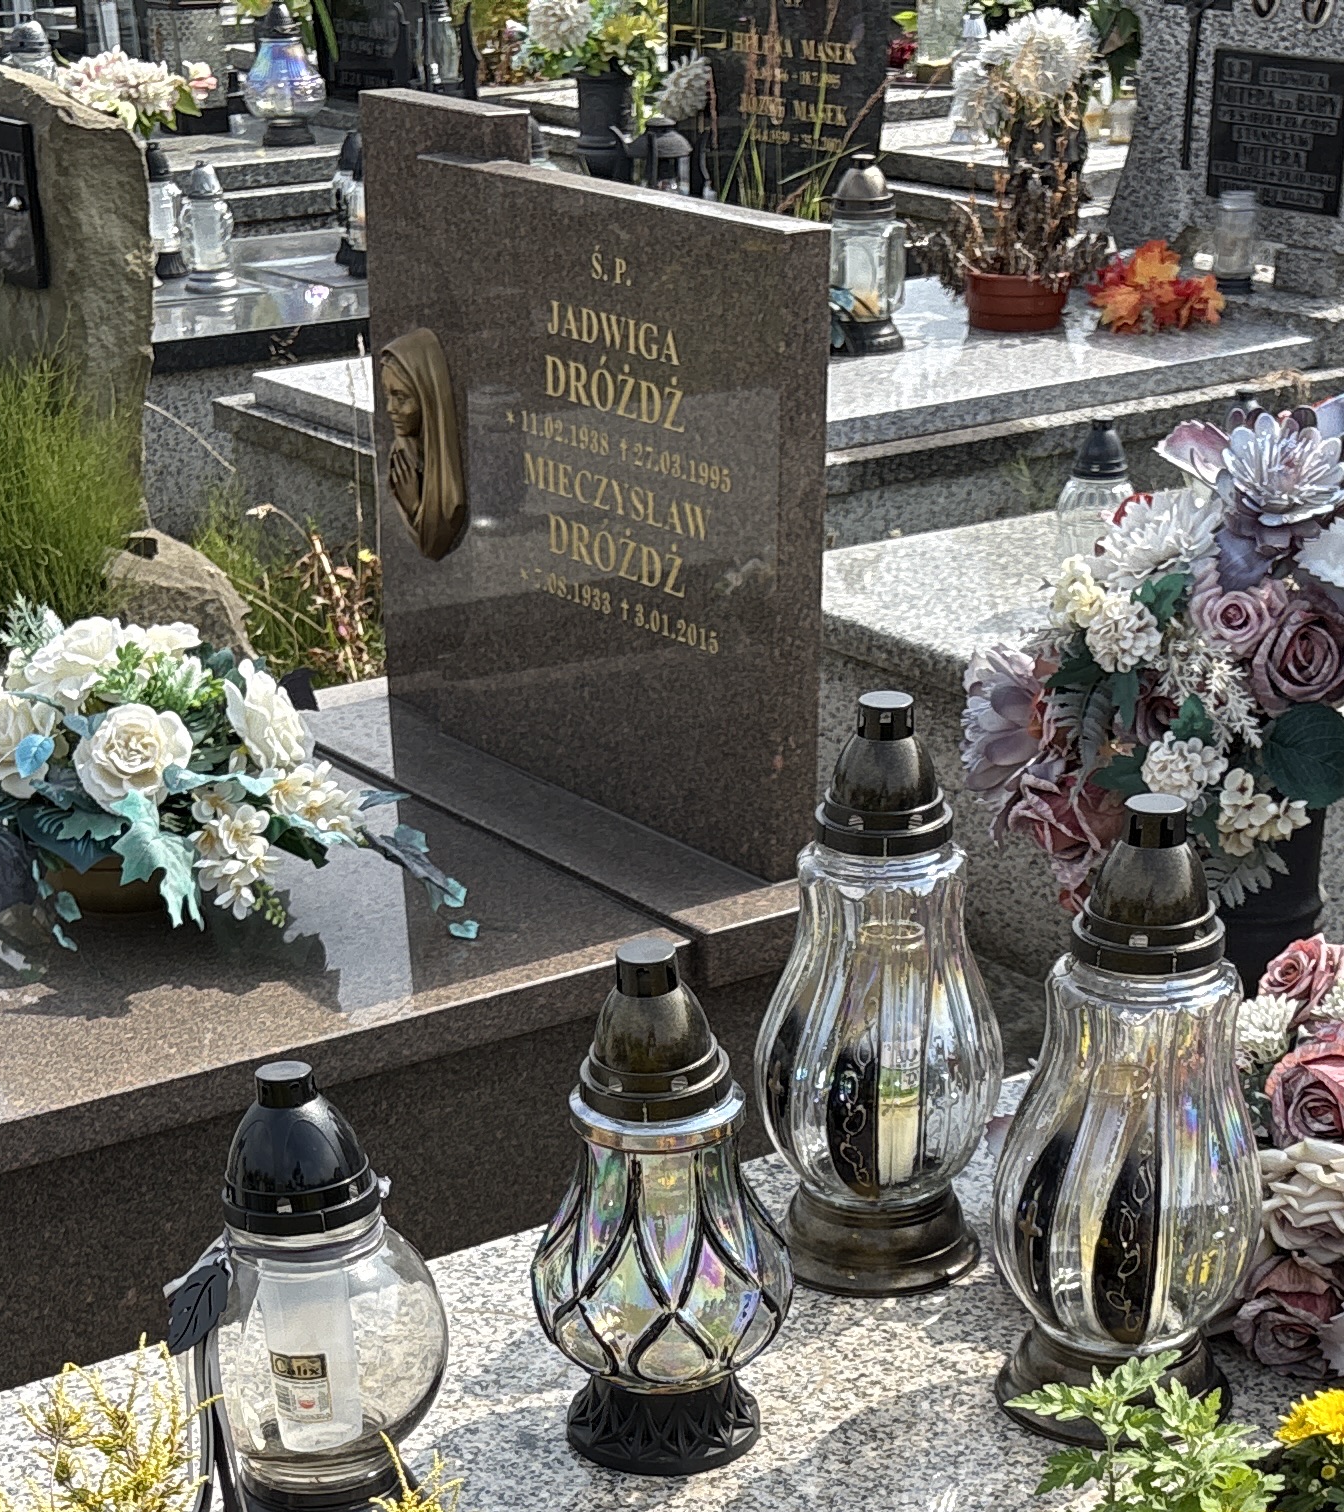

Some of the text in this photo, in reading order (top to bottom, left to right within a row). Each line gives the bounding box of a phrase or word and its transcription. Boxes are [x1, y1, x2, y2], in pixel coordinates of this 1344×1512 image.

[615, 258, 632, 287] P.
[547, 300, 681, 366] JADWIGA
[544, 354, 685, 433] DRÓŻDŻ
[523, 452, 712, 542] MIECZYSŁAW
[548, 512, 686, 598] DRÓŻDŻ
[634, 603, 719, 655] 3.01.2015
